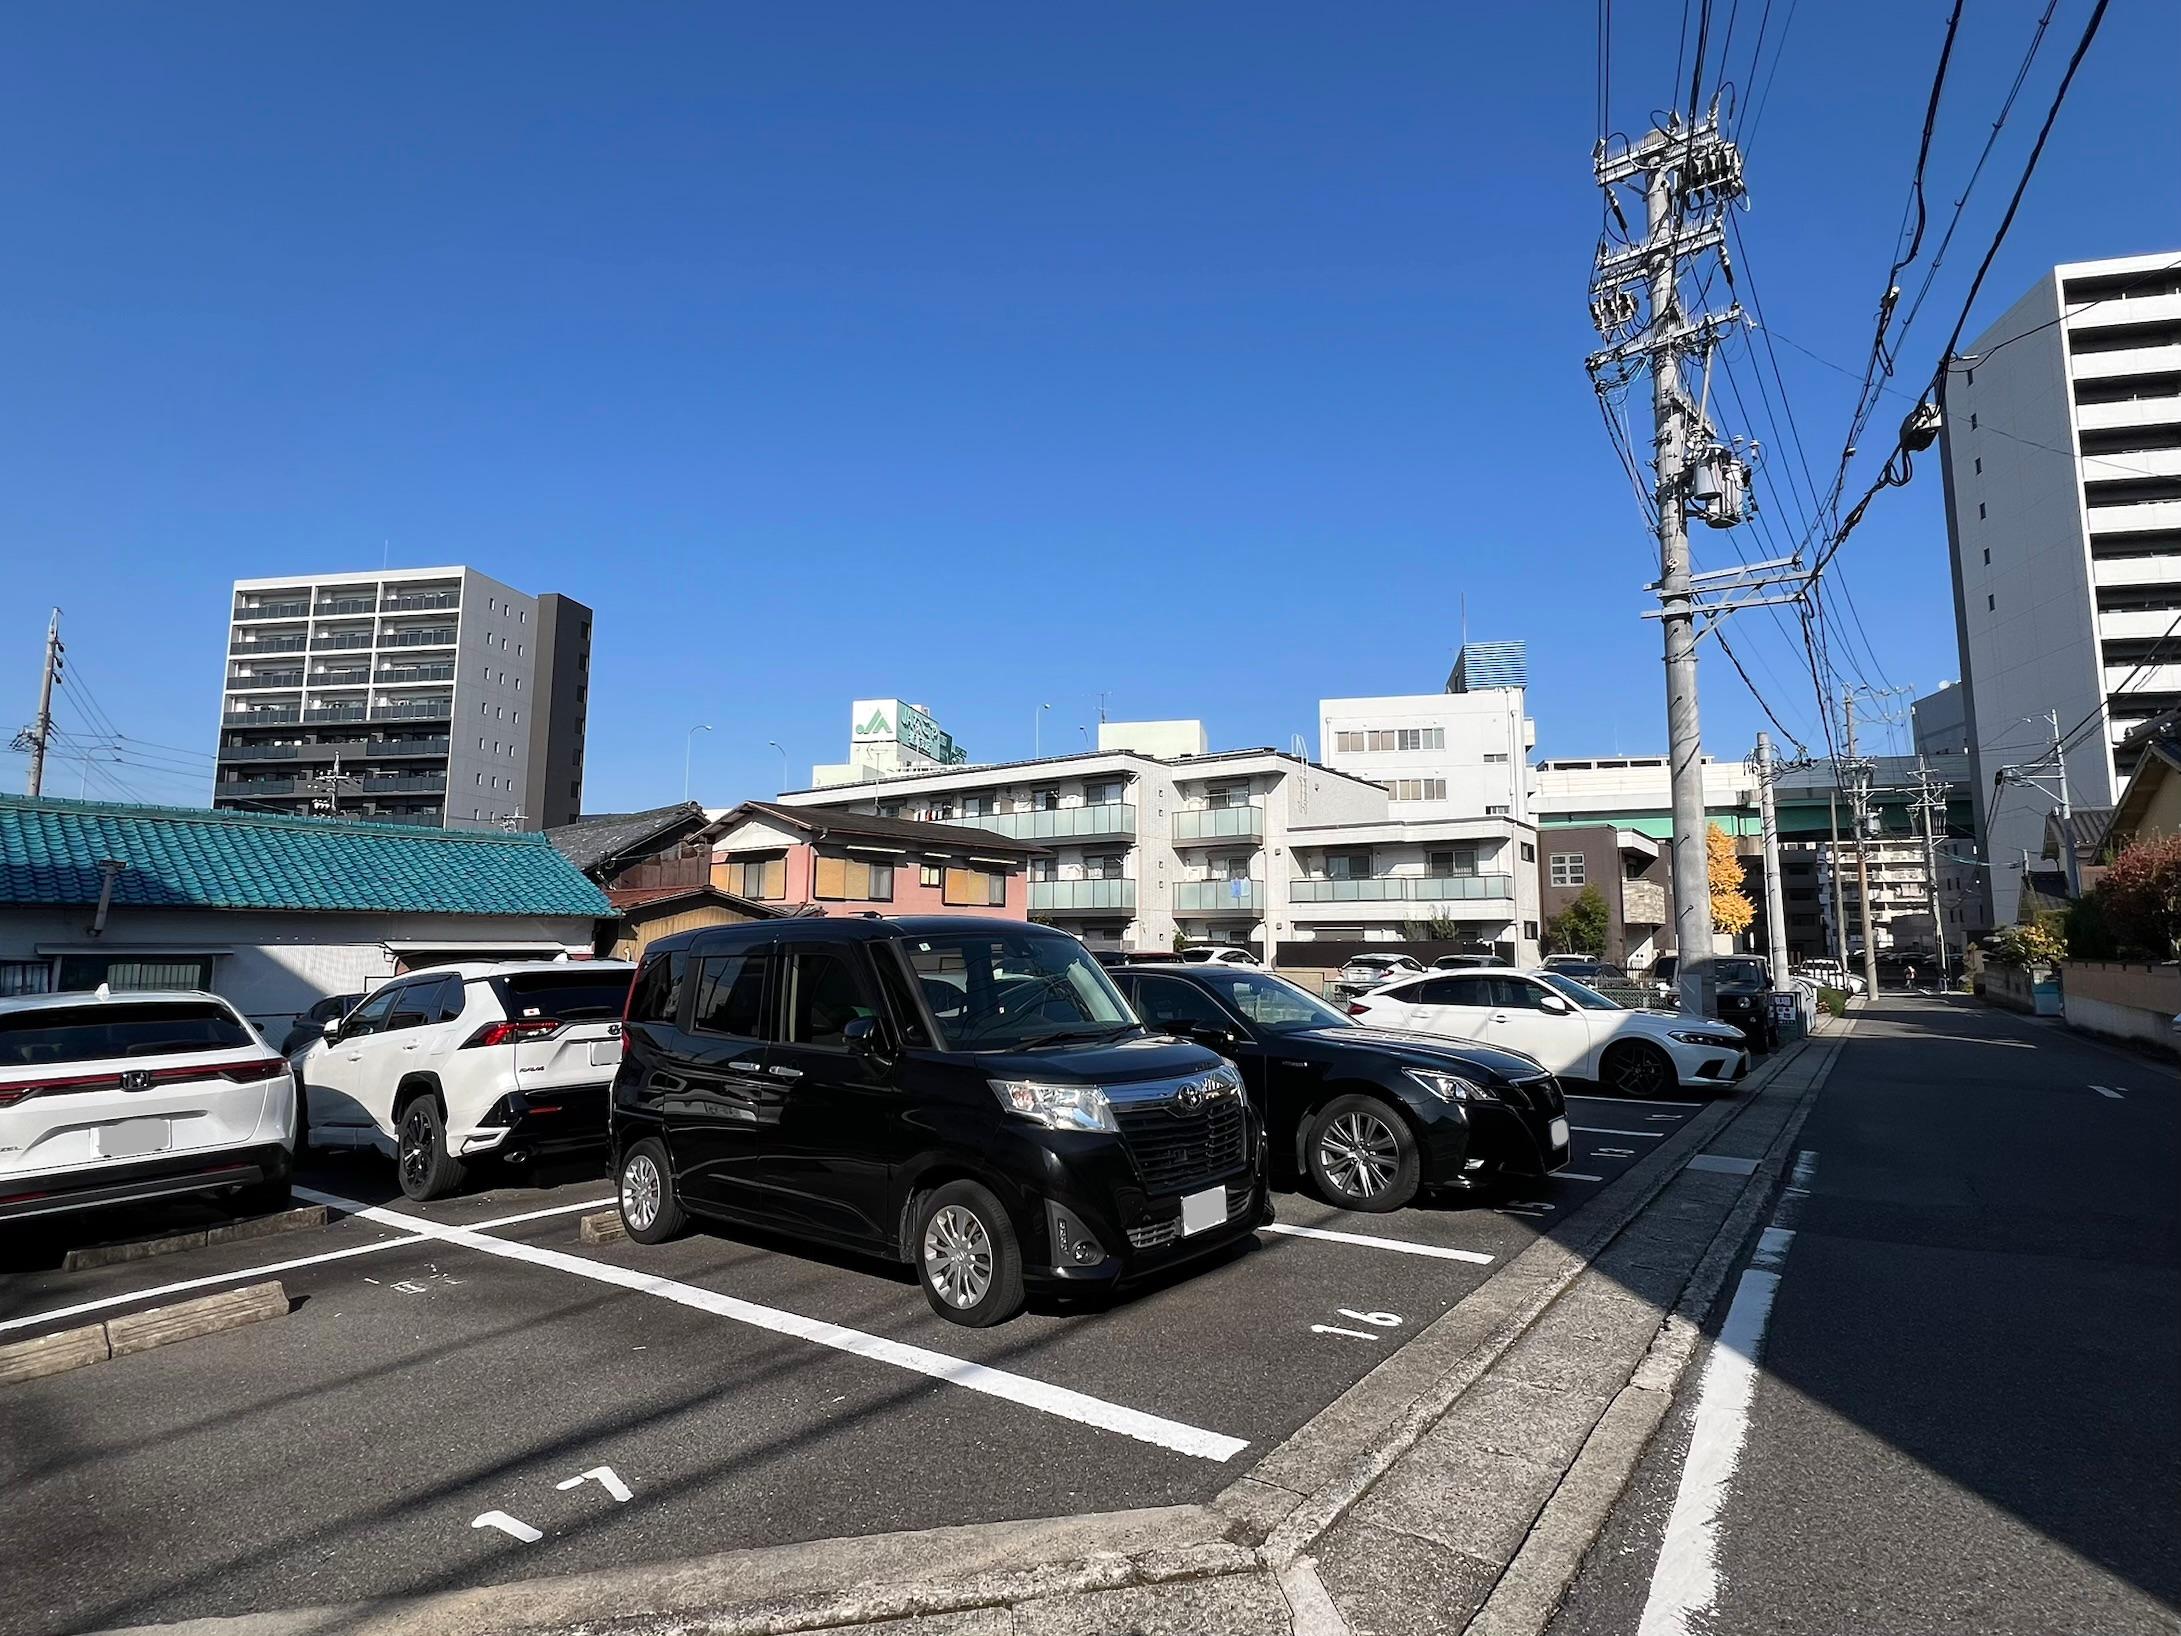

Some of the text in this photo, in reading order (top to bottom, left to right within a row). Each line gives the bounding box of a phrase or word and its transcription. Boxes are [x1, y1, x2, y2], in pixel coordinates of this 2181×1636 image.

[855, 708, 893, 734] JA
[1310, 1308, 1403, 1341] 16
[471, 1466, 635, 1544] 17
